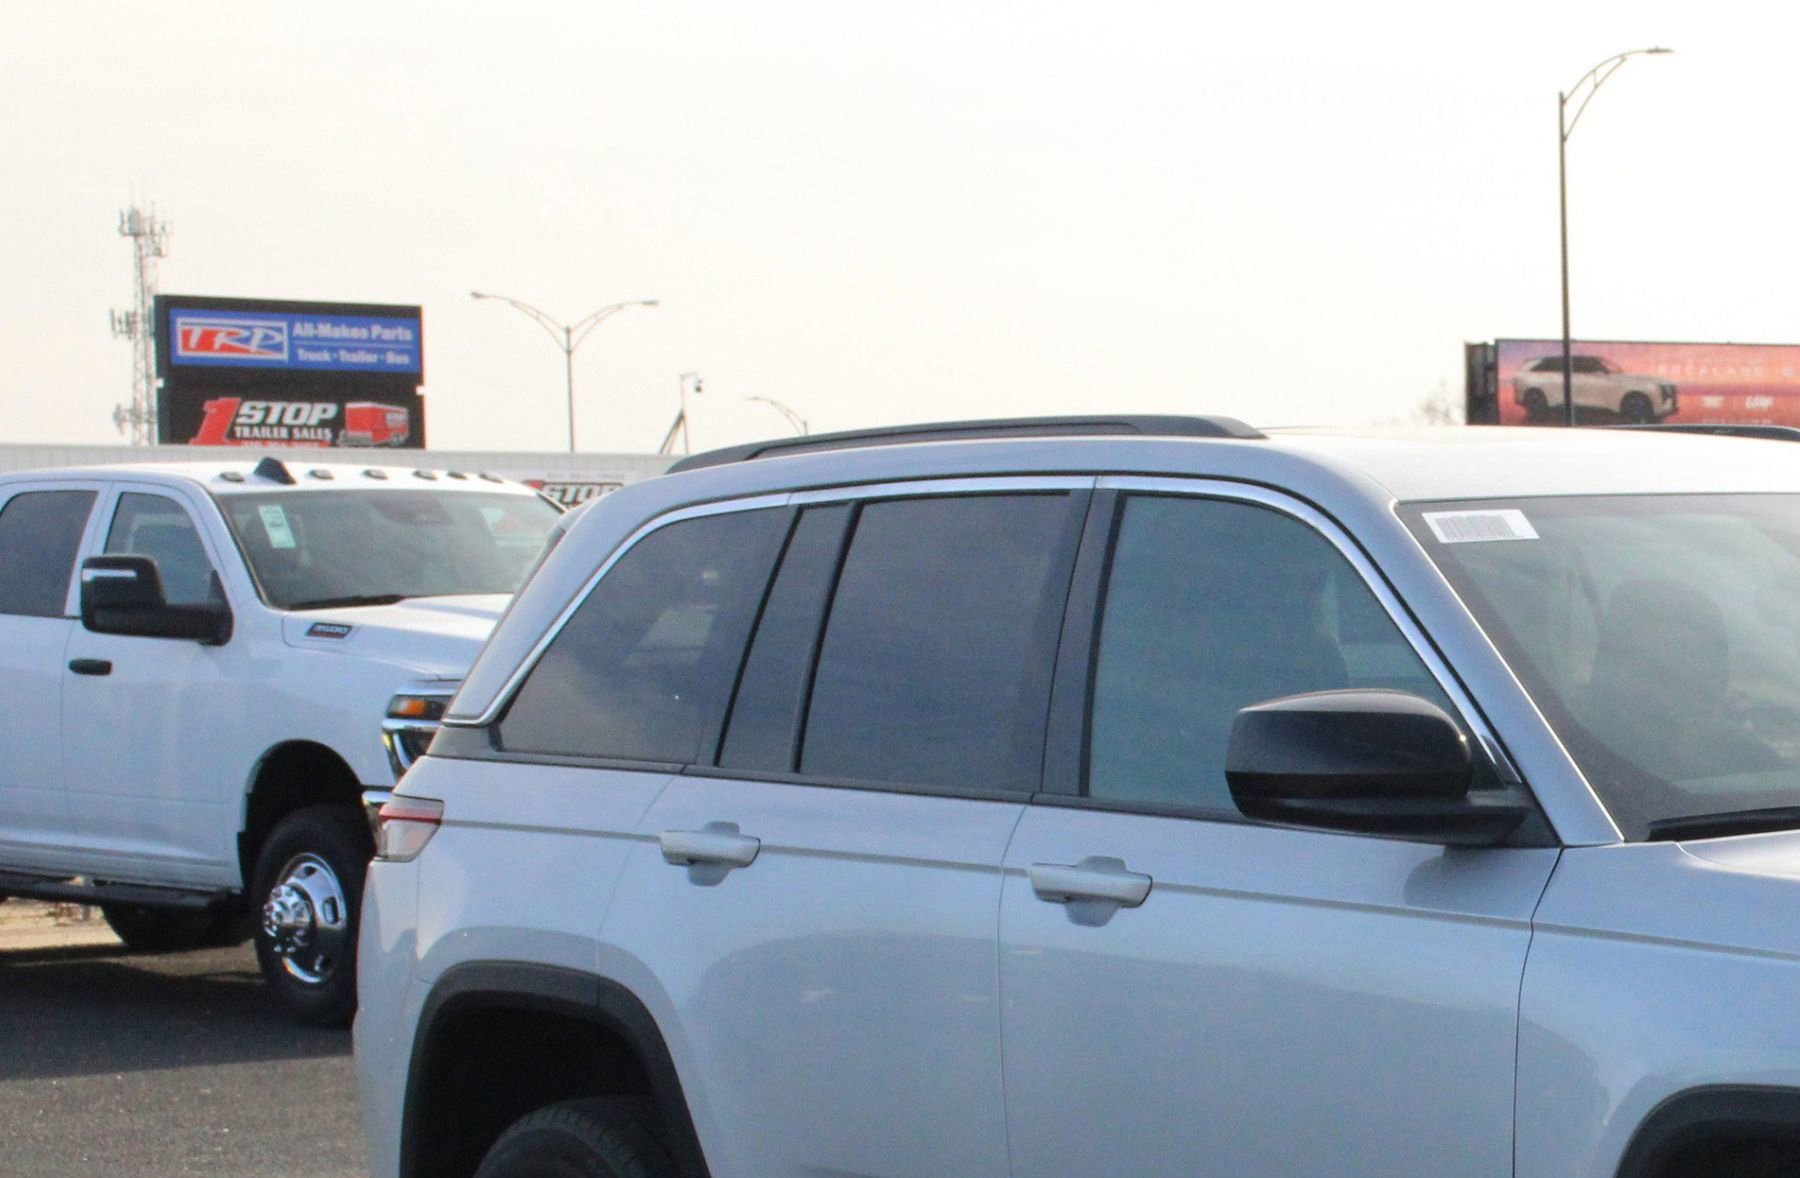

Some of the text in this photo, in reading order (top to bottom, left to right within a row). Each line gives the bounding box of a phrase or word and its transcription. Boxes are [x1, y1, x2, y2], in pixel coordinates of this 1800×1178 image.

[370, 325, 412, 341] Parts
[236, 401, 338, 425] STOP
[235, 426, 331, 440] TRAILER SALES
